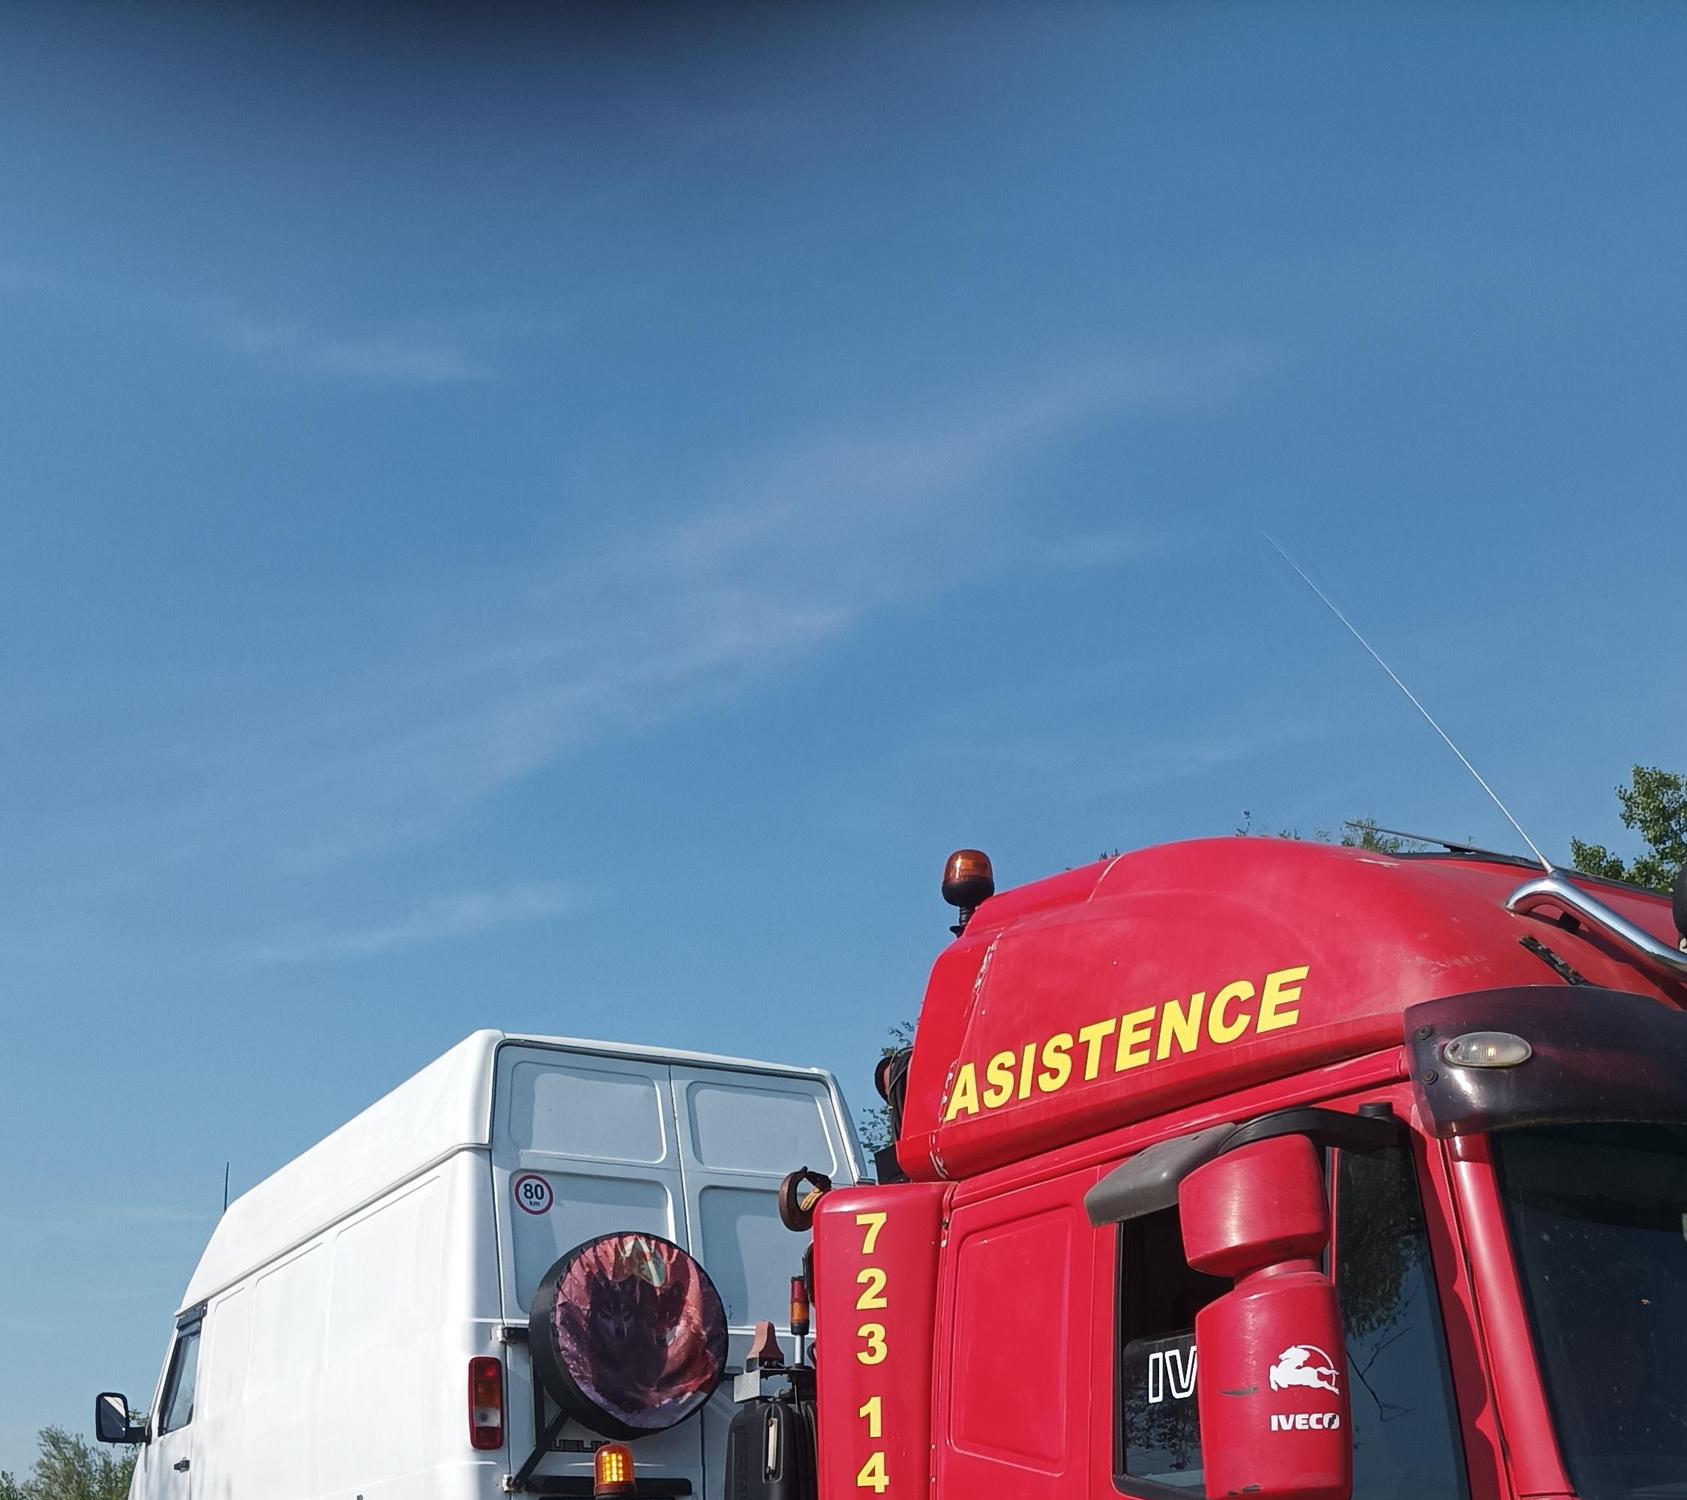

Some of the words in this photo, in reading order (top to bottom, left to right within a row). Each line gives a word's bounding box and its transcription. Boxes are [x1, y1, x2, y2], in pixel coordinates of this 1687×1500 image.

[944, 965, 1310, 1122] ASISTENCE
[523, 1183, 545, 1200] 80
[1148, 1346, 1198, 1404] IV
[1270, 1412, 1340, 1431] IVECO
